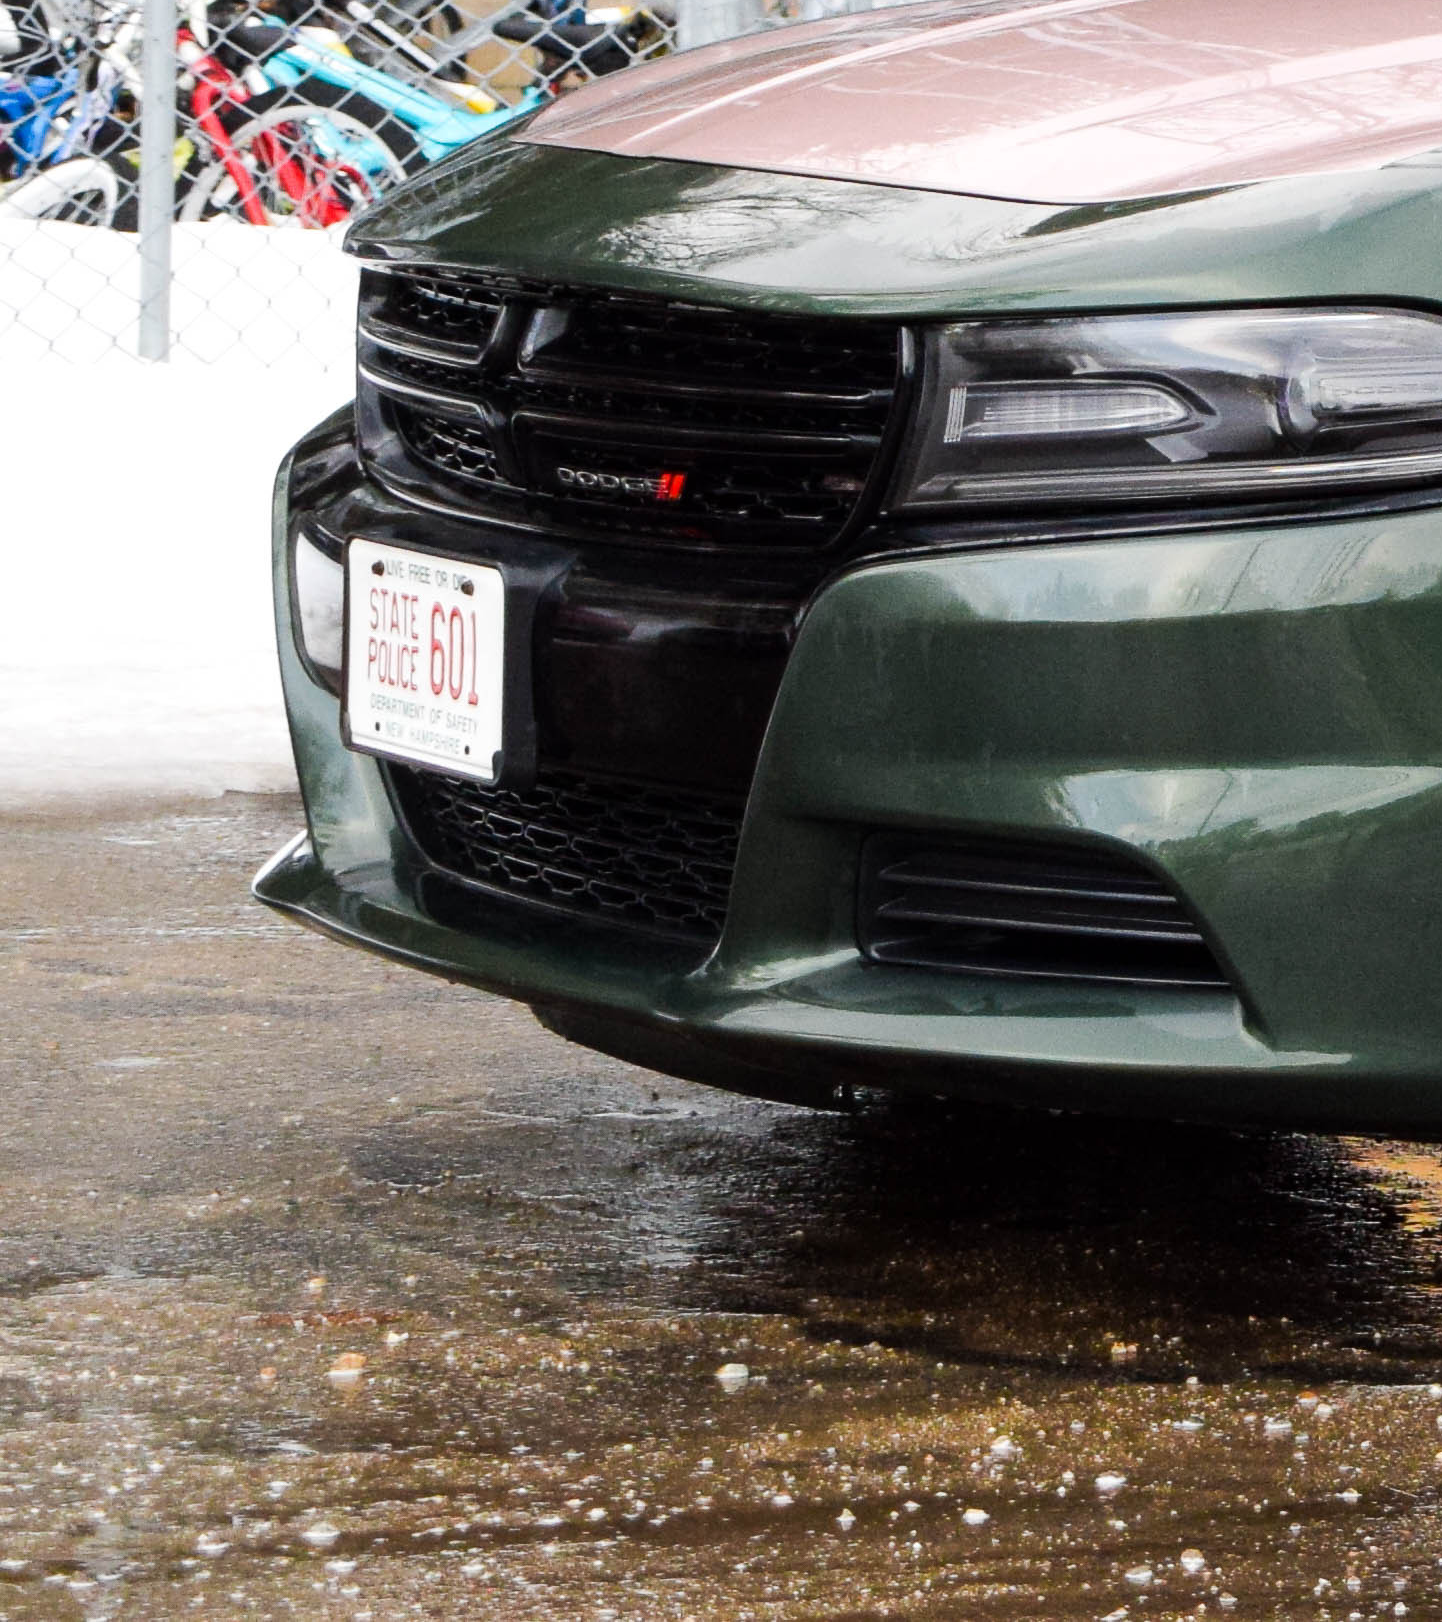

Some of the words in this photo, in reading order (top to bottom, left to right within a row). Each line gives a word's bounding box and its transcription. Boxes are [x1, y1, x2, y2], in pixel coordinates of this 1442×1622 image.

[557, 467, 668, 494] DODGE
[409, 563, 431, 585] FREE
[370, 588, 419, 640] STATE
[368, 636, 419, 691] POLICE
[430, 601, 479, 706] 601
[370, 692, 425, 719] DEPARTMENT
[446, 712, 478, 734] SAFETY
